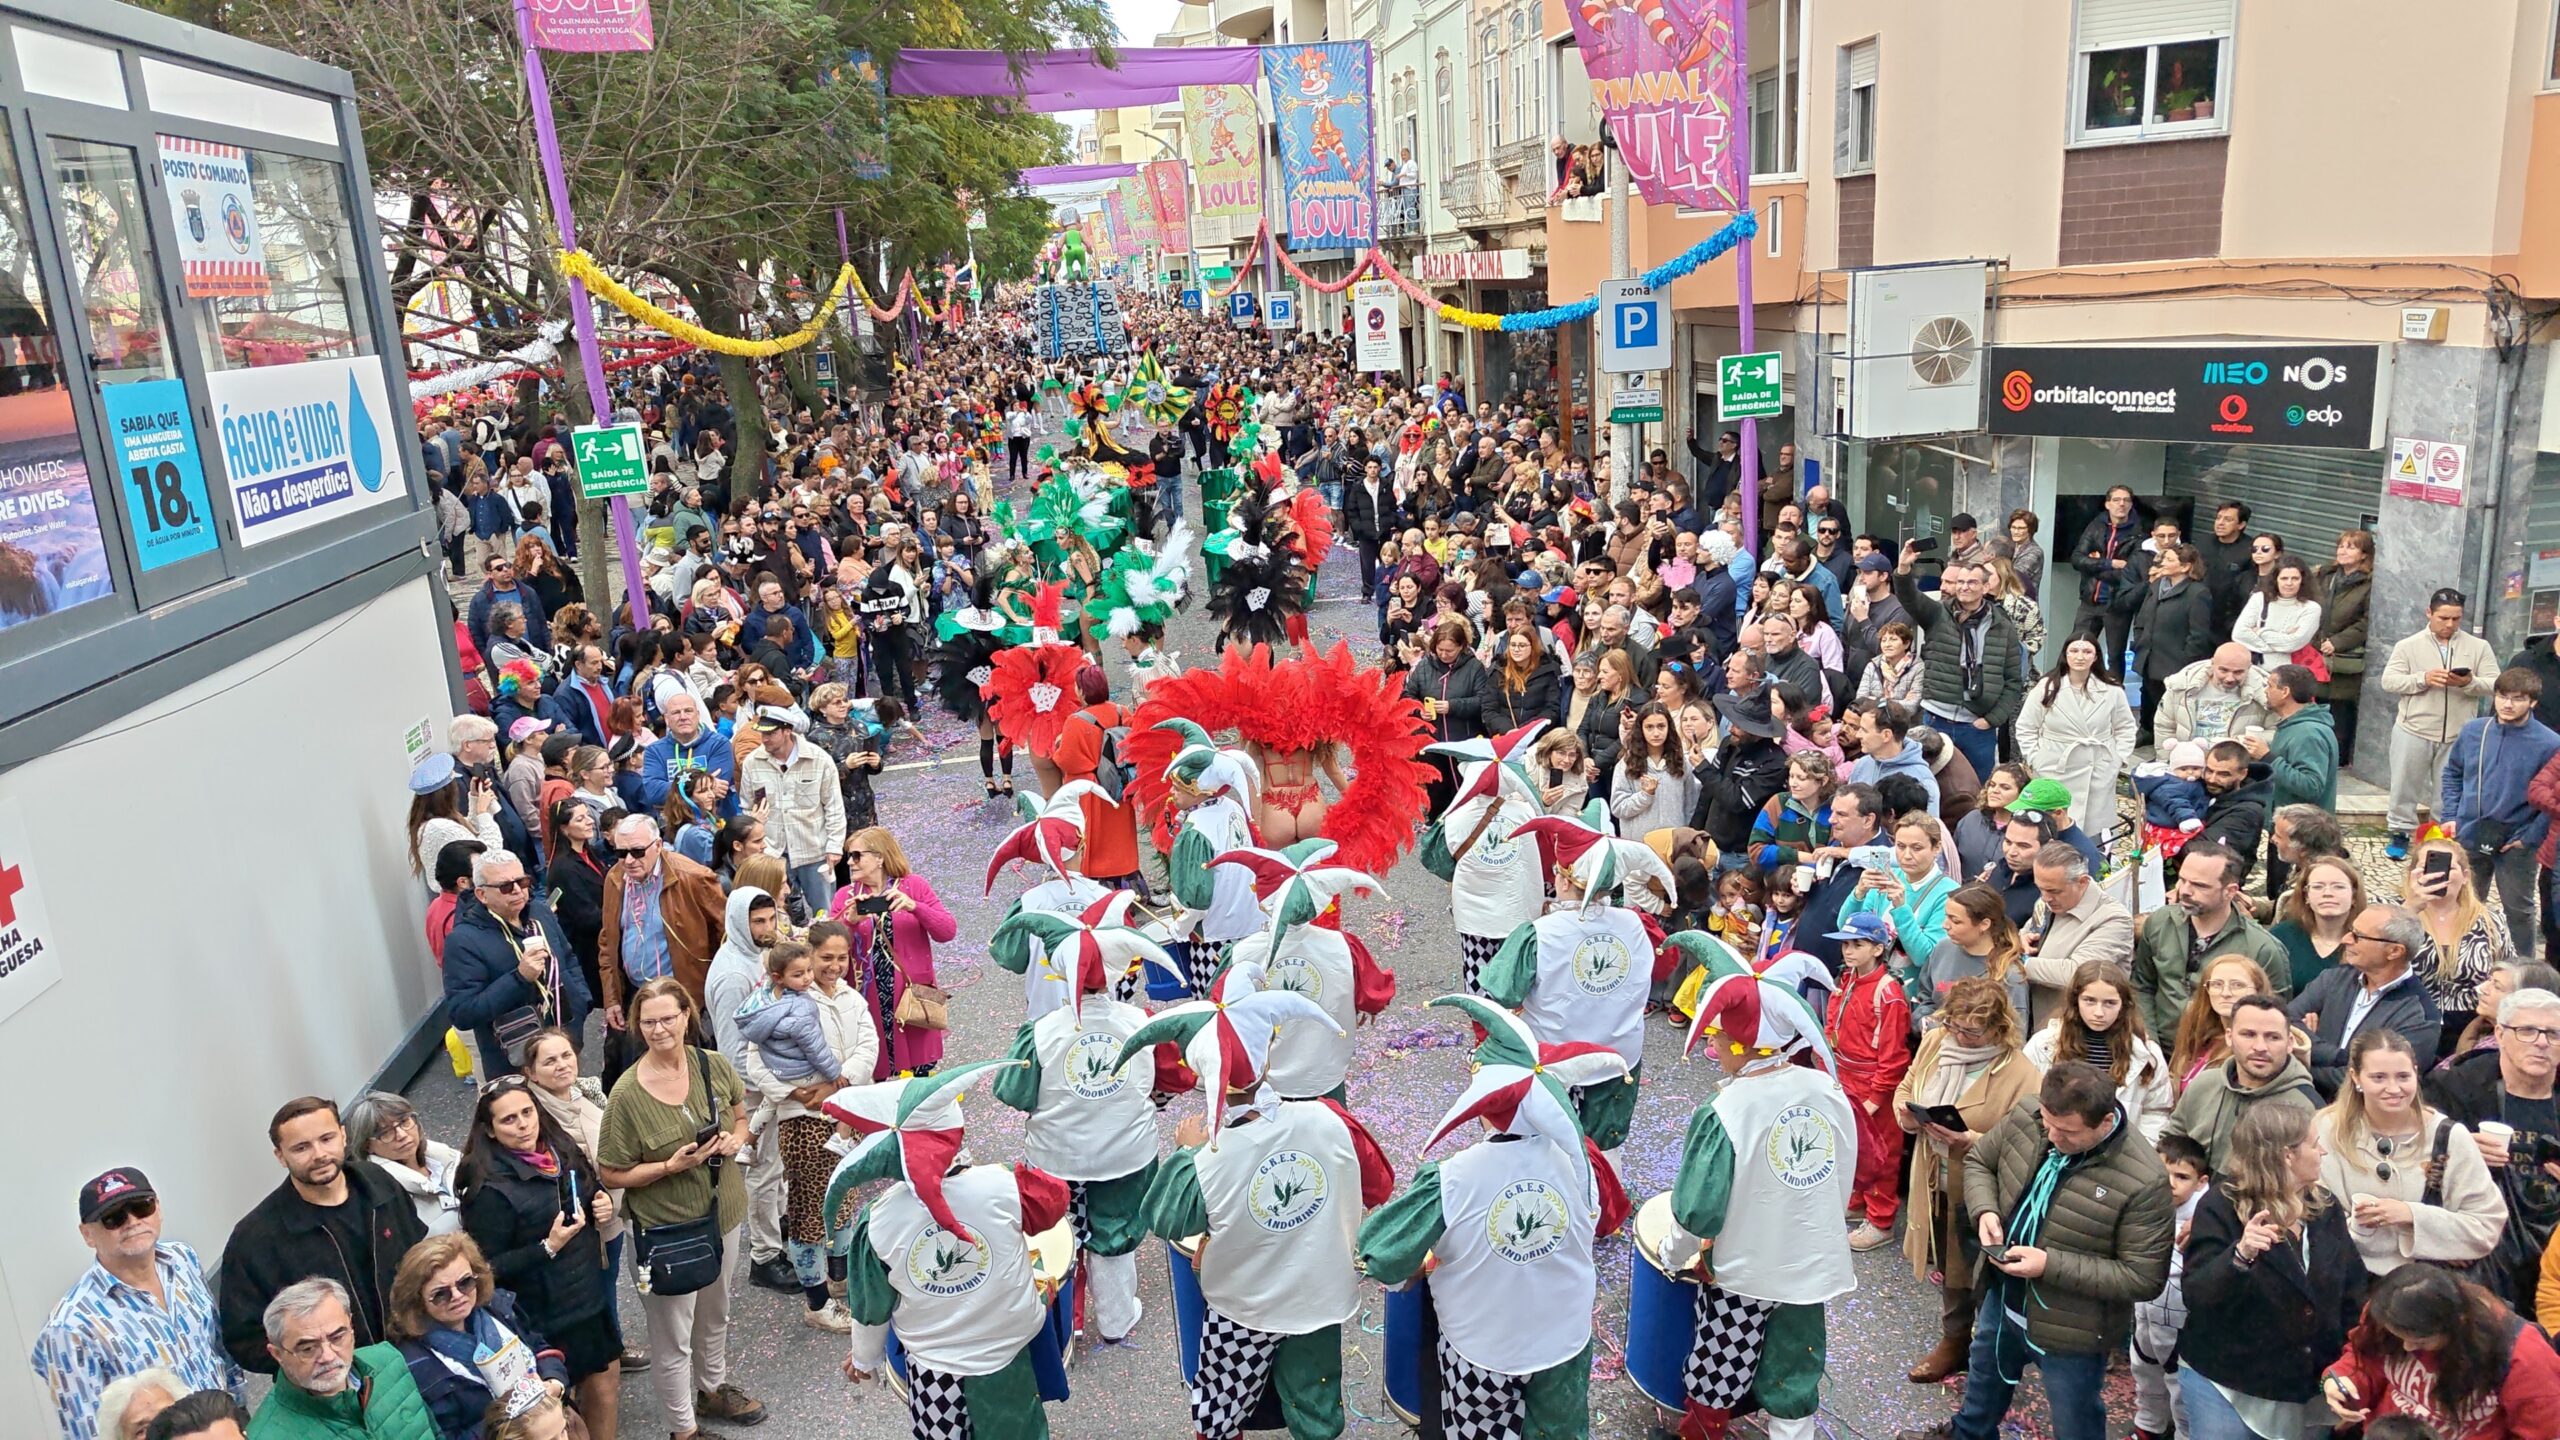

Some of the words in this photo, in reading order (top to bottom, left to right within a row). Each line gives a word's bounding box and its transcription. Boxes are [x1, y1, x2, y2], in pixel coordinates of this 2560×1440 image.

[547, 26, 575, 34] ANTIGO
[590, 26, 634, 34] PORTUGAL
[558, 17, 600, 25] CARNAVAL
[1590, 67, 1706, 111] RNAVAL
[1611, 89, 1726, 190] ULÉ
[162, 158, 197, 179] POSTO
[200, 163, 247, 184] COMANDO
[1199, 174, 1257, 209] LOULÉ
[1298, 180, 1361, 198] CARNAVAL
[1289, 192, 1371, 240] LOULÉ
[1422, 254, 1451, 280] BAZAR
[1454, 253, 1466, 279] DA
[1470, 250, 1504, 278] CHINA
[1620, 286, 1651, 297] zona
[1235, 295, 1249, 315] P
[1275, 304, 1285, 320] P
[1624, 306, 1649, 344] P
[2203, 361, 2268, 385] MEO
[2283, 357, 2347, 391] NOS
[1724, 400, 1780, 412] EMERGÊNCIA
[1732, 392, 1758, 401] SAÍDA
[2034, 386, 2176, 407] orbitalconnect
[2112, 405, 2136, 414] Agente
[2137, 405, 2175, 414] Autorizado
[2211, 423, 2254, 433] vodafone
[2306, 404, 2342, 427] edp
[120, 415, 156, 433] SABIA
[158, 411, 180, 430] QUE
[124, 434, 141, 448] UMA
[142, 429, 183, 446] MANGUEIRA
[222, 403, 288, 480] ÁGUA
[284, 408, 300, 458] é
[293, 400, 345, 463] VIDA
[128, 448, 160, 462] ABERTA
[160, 442, 186, 457] GASTA
[591, 469, 620, 479] SAÍDA
[622, 468, 634, 476] DE
[240, 488, 270, 520] Não
[271, 488, 282, 510] a
[282, 468, 349, 508] desperdice
[584, 478, 646, 491] EMERGÊNCIA
[18, 489, 70, 516] DIVES.
[34, 523, 49, 534] Save
[48, 520, 66, 531] Water
[146, 538, 154, 548] DE
[155, 532, 170, 546] ÁGUA
[170, 532, 182, 542] POR
[1480, 849, 1517, 865] ANDORINHA
[0, 937, 44, 978] GUESA
[1580, 975, 1625, 994] ANDORINHA
[1073, 1079, 1124, 1098] ANDORINHA
[1780, 1160, 1834, 1187] ANDORINHA
[1264, 1197, 1324, 1230] ANDORINHA
[1498, 1235, 1562, 1262] ANDORINHA
[921, 1271, 986, 1294] ANDORINHA
